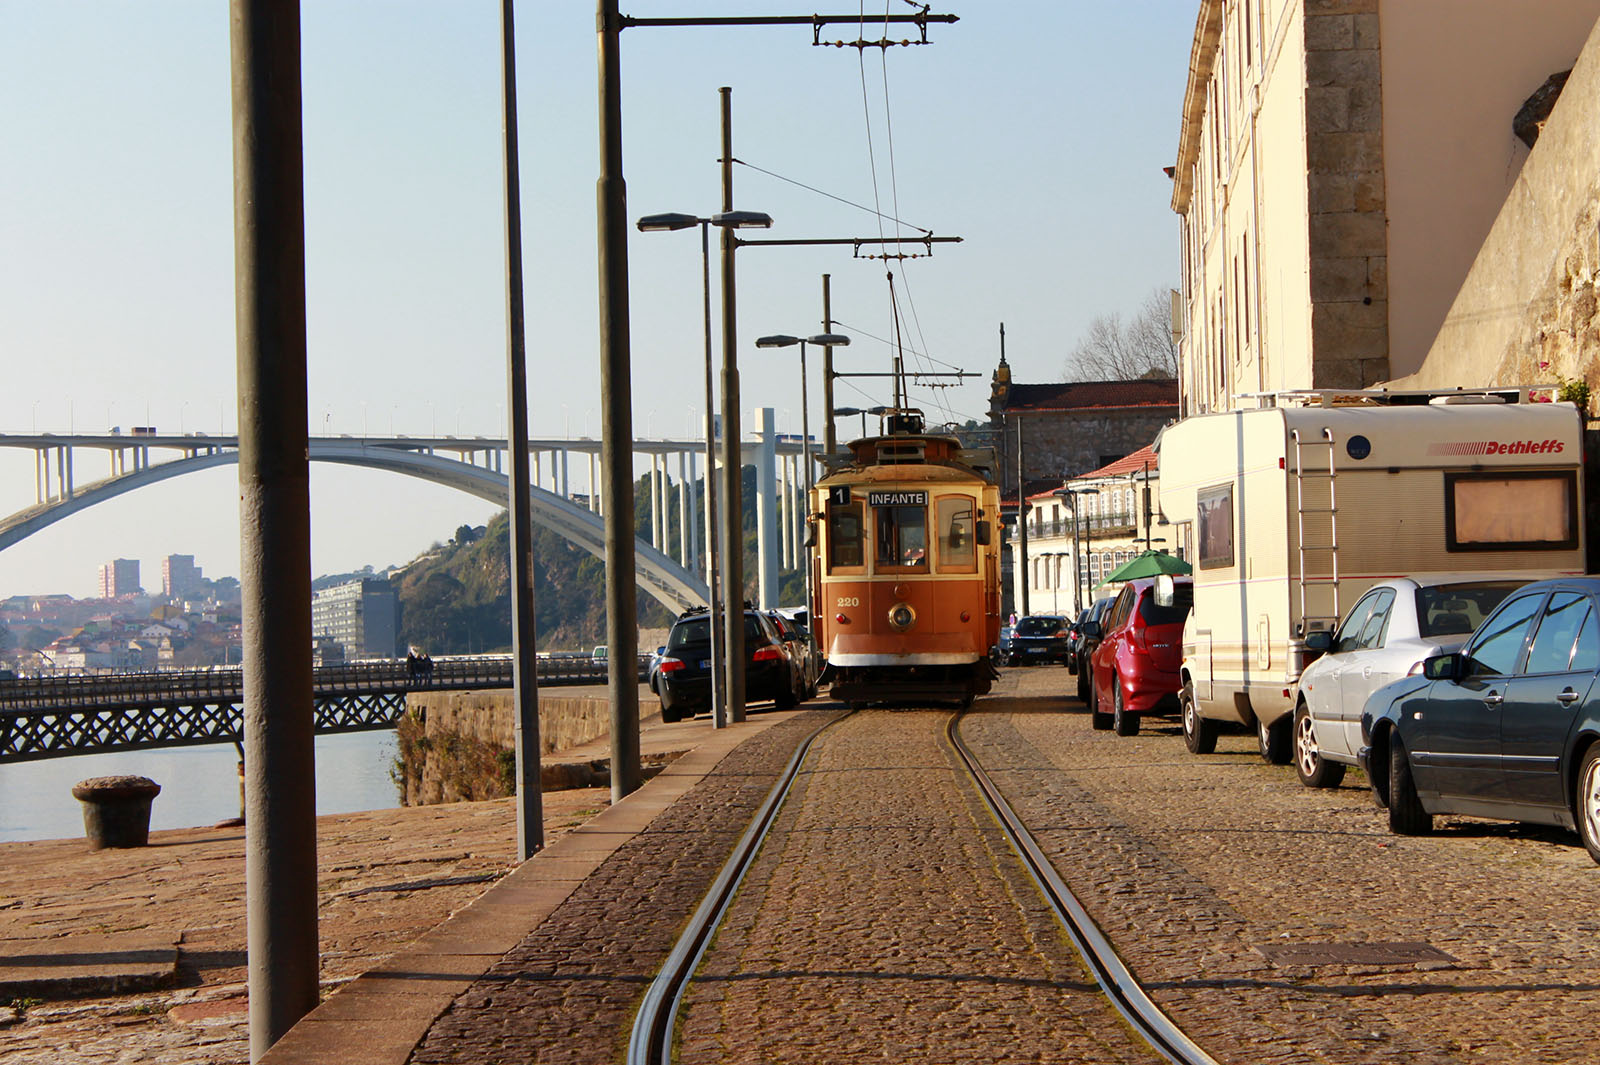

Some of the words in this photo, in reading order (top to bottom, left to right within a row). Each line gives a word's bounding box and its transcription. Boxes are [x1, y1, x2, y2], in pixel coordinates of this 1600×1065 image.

[1485, 439, 1565, 455] Dethleffs
[835, 488, 844, 504] 1
[871, 493, 923, 504] INFANTE
[837, 597, 860, 607] 220
